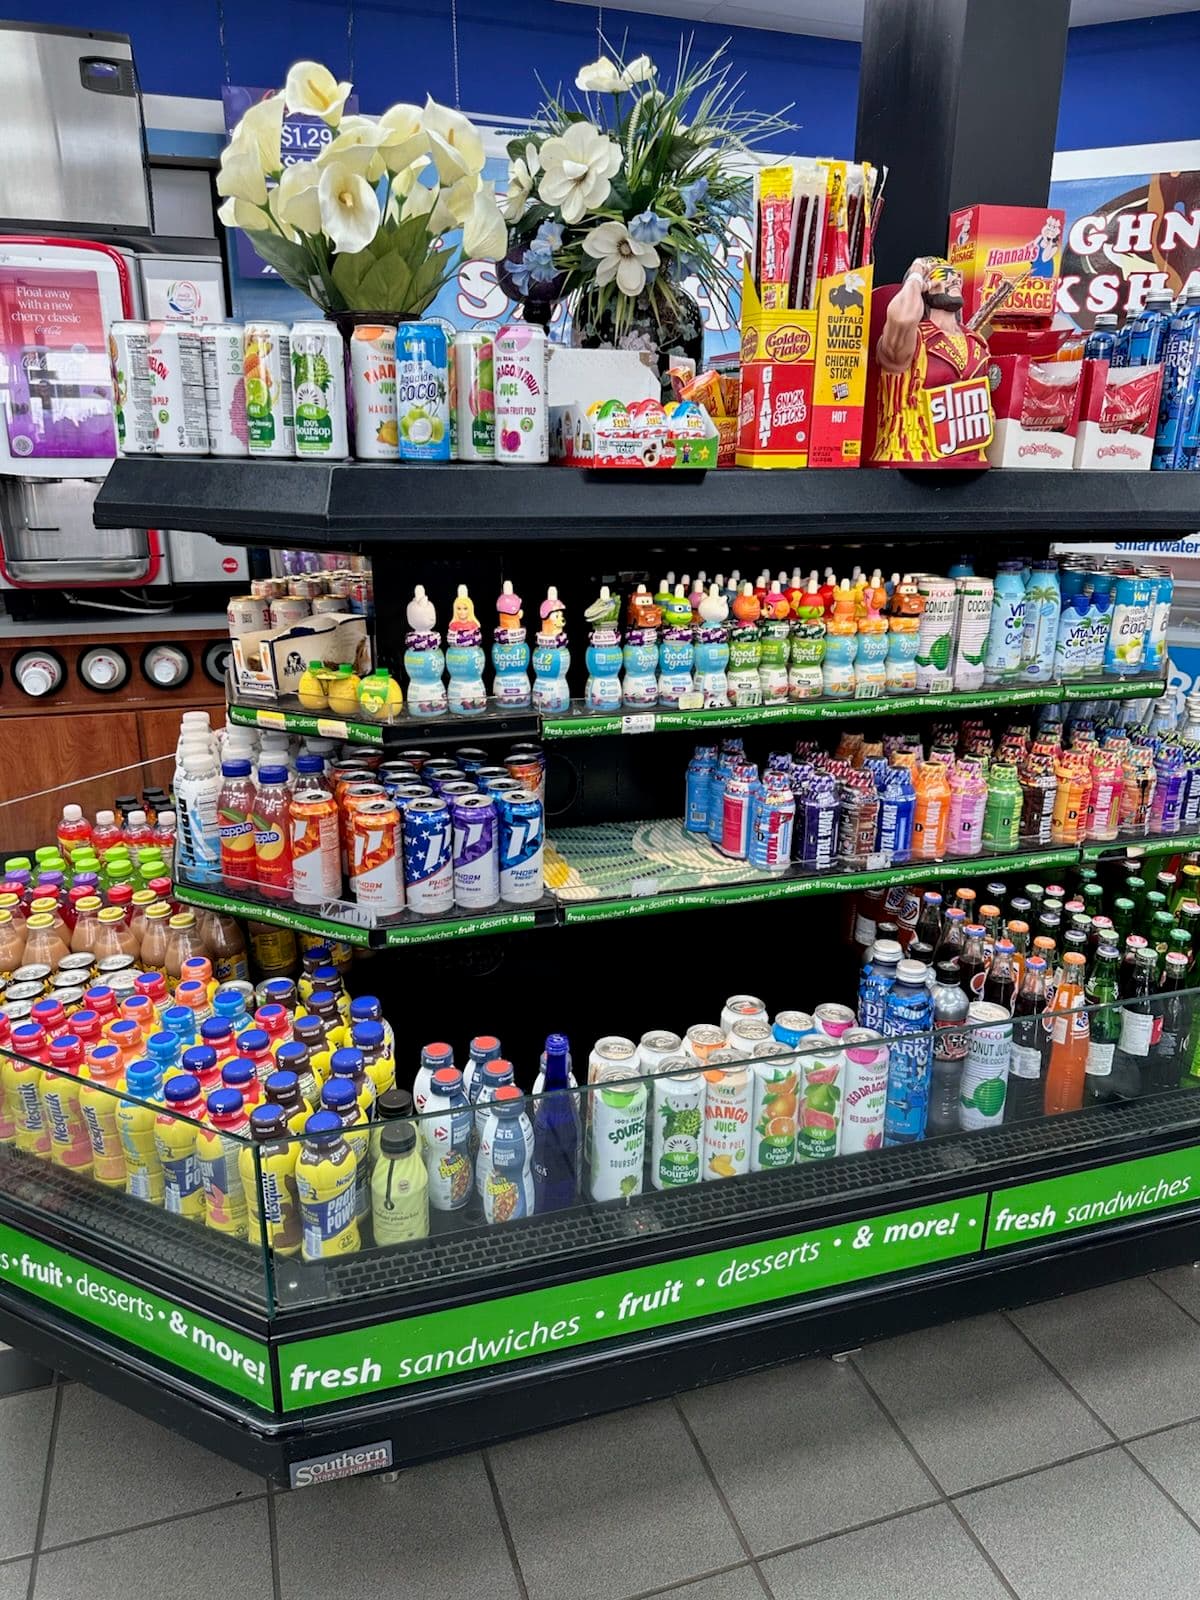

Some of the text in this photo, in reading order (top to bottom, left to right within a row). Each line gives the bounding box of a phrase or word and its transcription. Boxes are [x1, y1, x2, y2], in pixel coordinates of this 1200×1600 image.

[987, 245, 1038, 267] Hannah's
[16, 287, 71, 301] Float away
[11, 313, 81, 325] cherry classic
[827, 316, 864, 324] BUFFALO
[767, 332, 808, 346] Golden
[827, 325, 863, 338] WILD
[771, 343, 807, 357] Flake
[827, 339, 862, 350] WINGS
[825, 355, 860, 368] CHICKEN
[829, 367, 852, 379] STICK
[379, 382, 396, 394] JUIC
[400, 382, 437, 402] COCO
[158, 396, 169, 405] PULP
[777, 389, 804, 408] SNACK
[773, 405, 806, 427] STICKS
[831, 411, 847, 423] HOT
[1070, 629, 1088, 639] VITA
[1091, 626, 1109, 637] VITA
[821, 709, 837, 718] fresh
[875, 704, 889, 713] fruit
[925, 699, 943, 707] more!
[656, 715, 662, 723] &
[663, 715, 683, 724] more!
[703, 708, 790, 727] sandwiches desserts
[545, 726, 563, 735] fresh
[564, 726, 603, 736] sandwiches
[607, 721, 623, 731] fruit
[1097, 785, 1113, 809] WAR
[882, 805, 898, 829] WAR
[1039, 789, 1057, 844] TOTAL WAR
[816, 810, 834, 870] TOTAL WAR
[836, 868, 959, 890] fresh fruit more!
[567, 913, 586, 921] fresh
[586, 910, 625, 921] sandwiches
[629, 905, 645, 914] fruit
[650, 898, 674, 910] desserts
[678, 896, 684, 904] &
[685, 896, 706, 904] more!
[785, 883, 812, 894] desserts
[223, 903, 364, 942] fruit desserts & more! sandwiches fruit
[388, 915, 519, 944] fresh sandwiches fruit desserts &
[846, 1080, 887, 1106] RED DRAGO
[22, 1083, 42, 1131] Nesquik
[705, 1105, 749, 1124] MANGO
[45, 1093, 69, 1143] Nesquik
[83, 1106, 105, 1154] Nesquik
[608, 1120, 645, 1144] SOURS
[713, 1122, 737, 1133] JUICE
[705, 1137, 745, 1150] MANGO PULP
[815, 1143, 836, 1153] Guava
[610, 1157, 638, 1169] SOURSOP
[765, 1151, 792, 1162] Orange
[772, 1159, 787, 1167] Juice
[660, 1165, 698, 1178] Soursop
[673, 1164, 689, 1172] 100%
[994, 1175, 1193, 1232] fresh sandwiches
[290, 1212, 960, 1391] fresh sandwiches fruit desserts & more!
[21, 1254, 266, 1385] fruit desserts & more!
[296, 1447, 388, 1487] Southern
